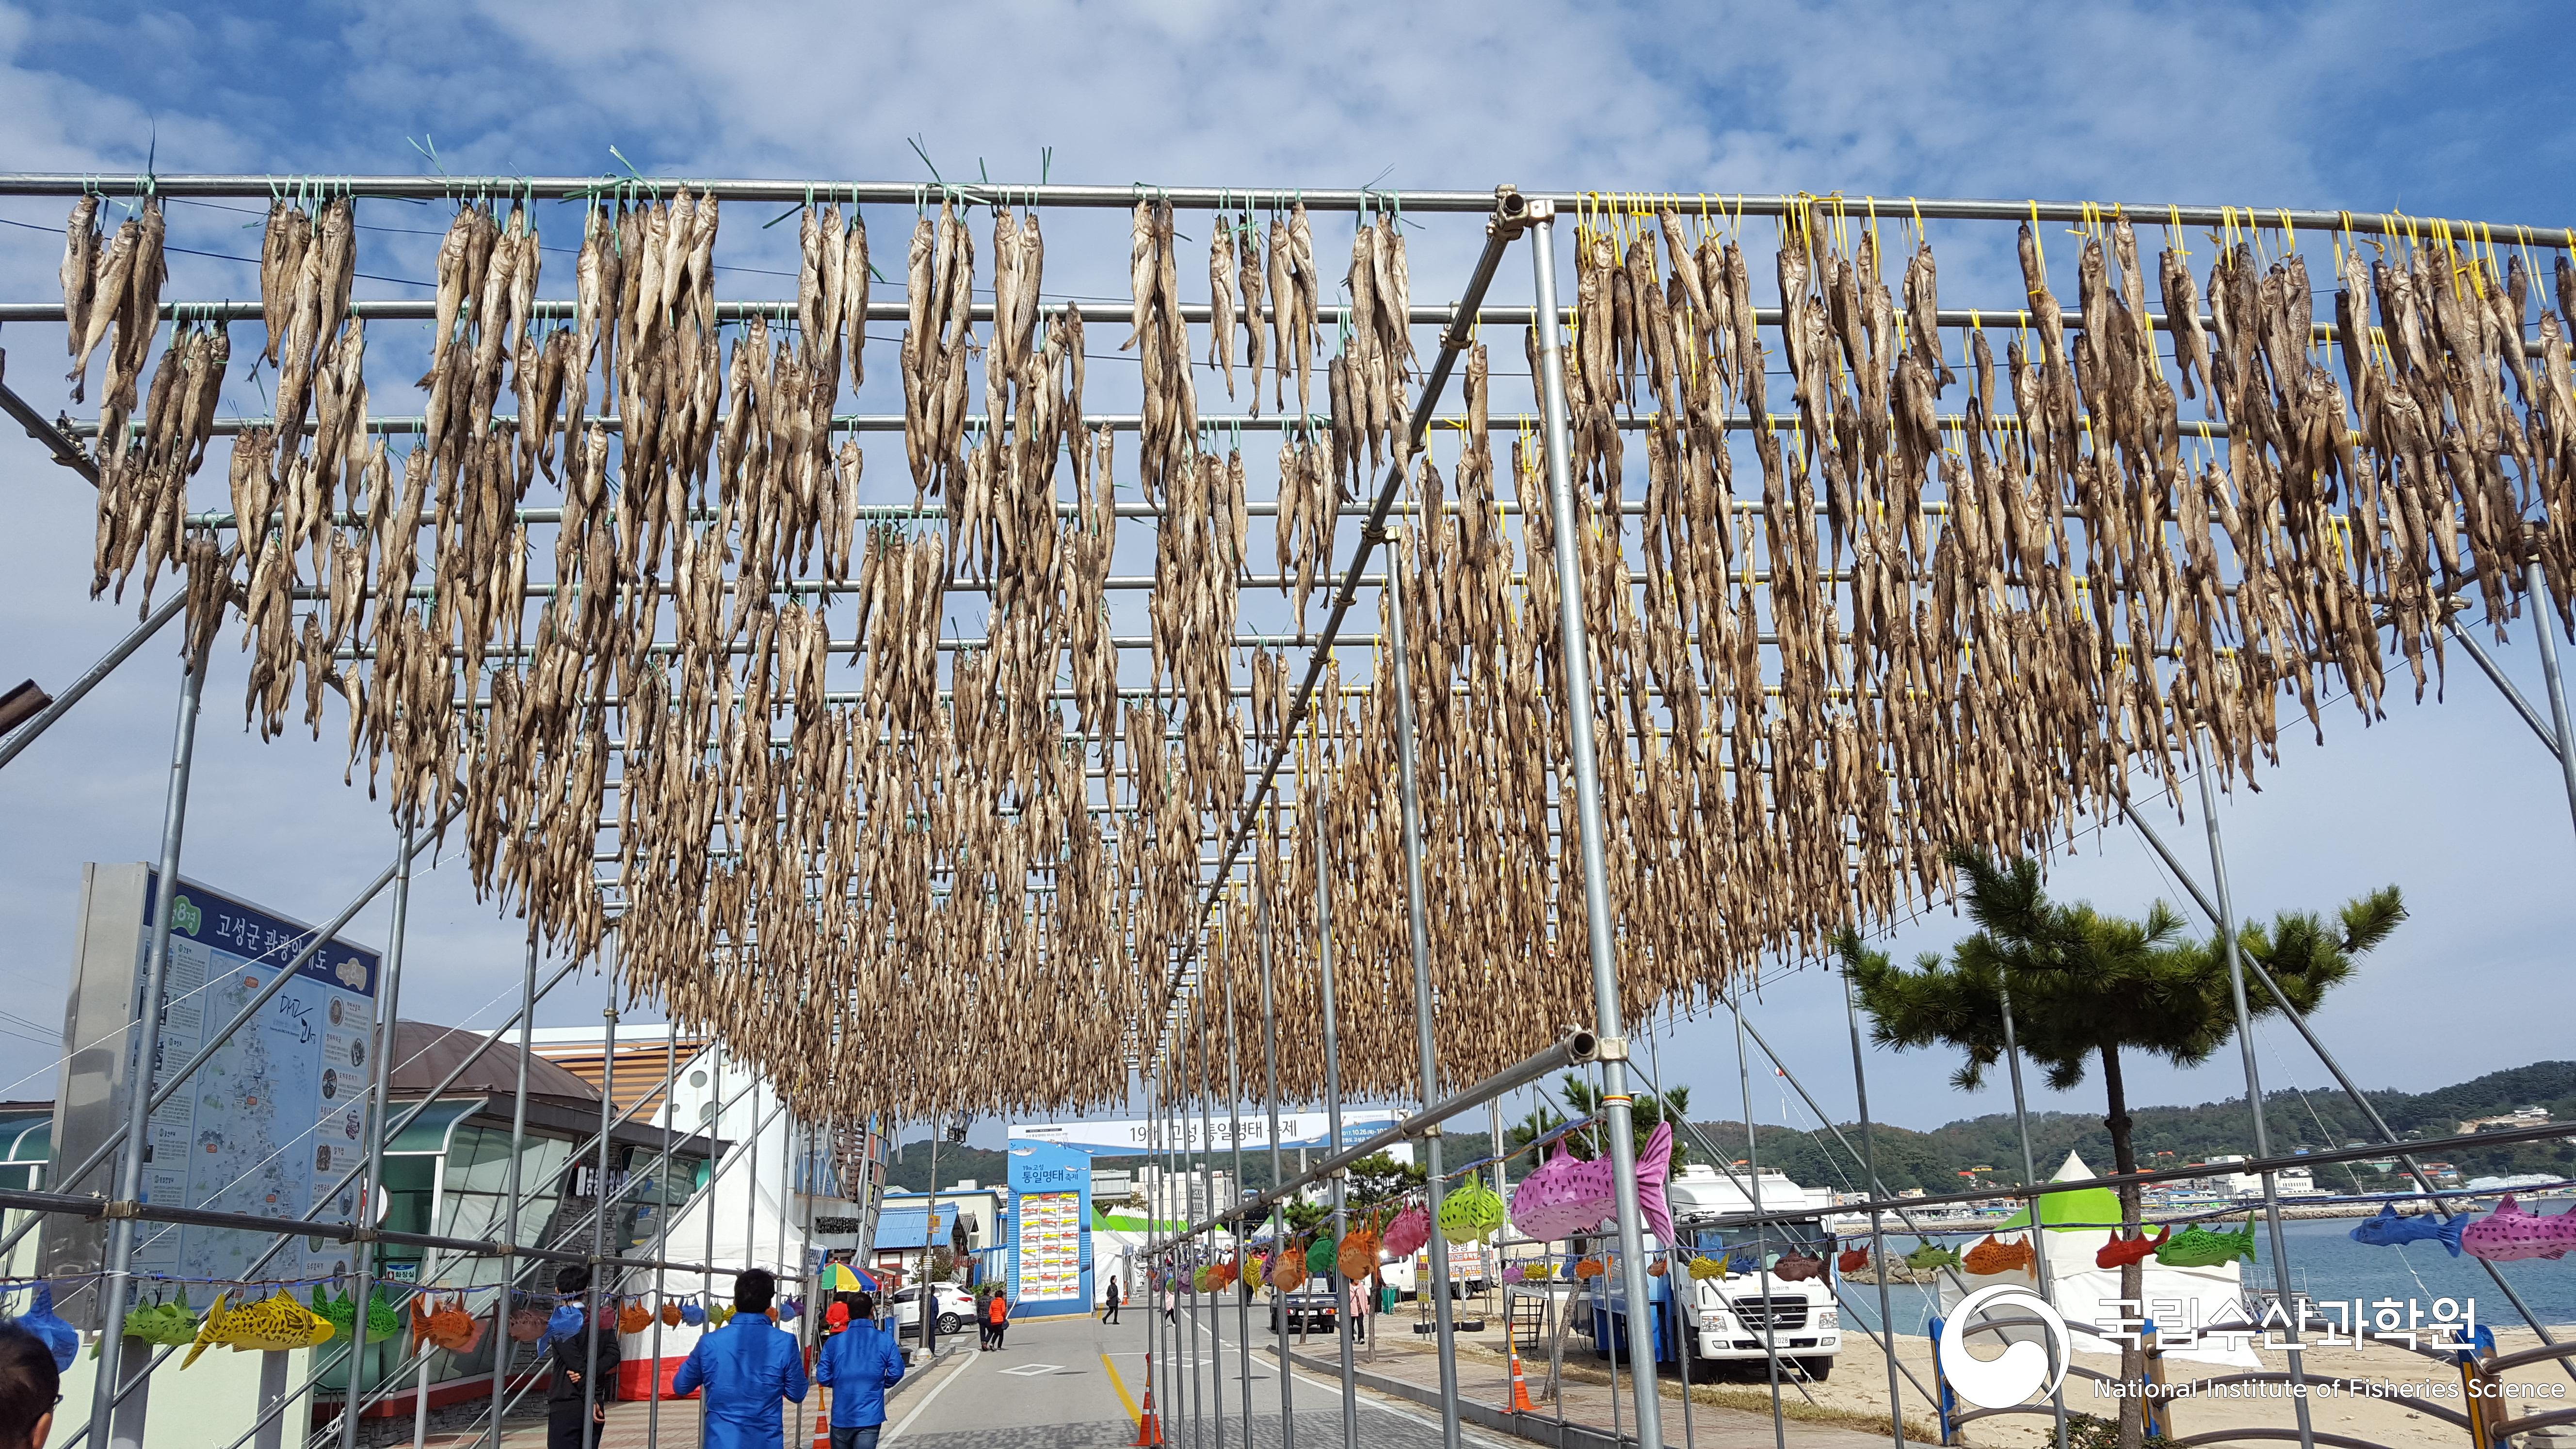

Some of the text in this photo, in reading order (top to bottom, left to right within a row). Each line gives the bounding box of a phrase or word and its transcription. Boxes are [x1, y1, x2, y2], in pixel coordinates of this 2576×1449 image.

[216, 914, 260, 951] 고성군
[1130, 1126, 1158, 1142] 19h
[1022, 1170, 1079, 1184] 통일명태 축제
